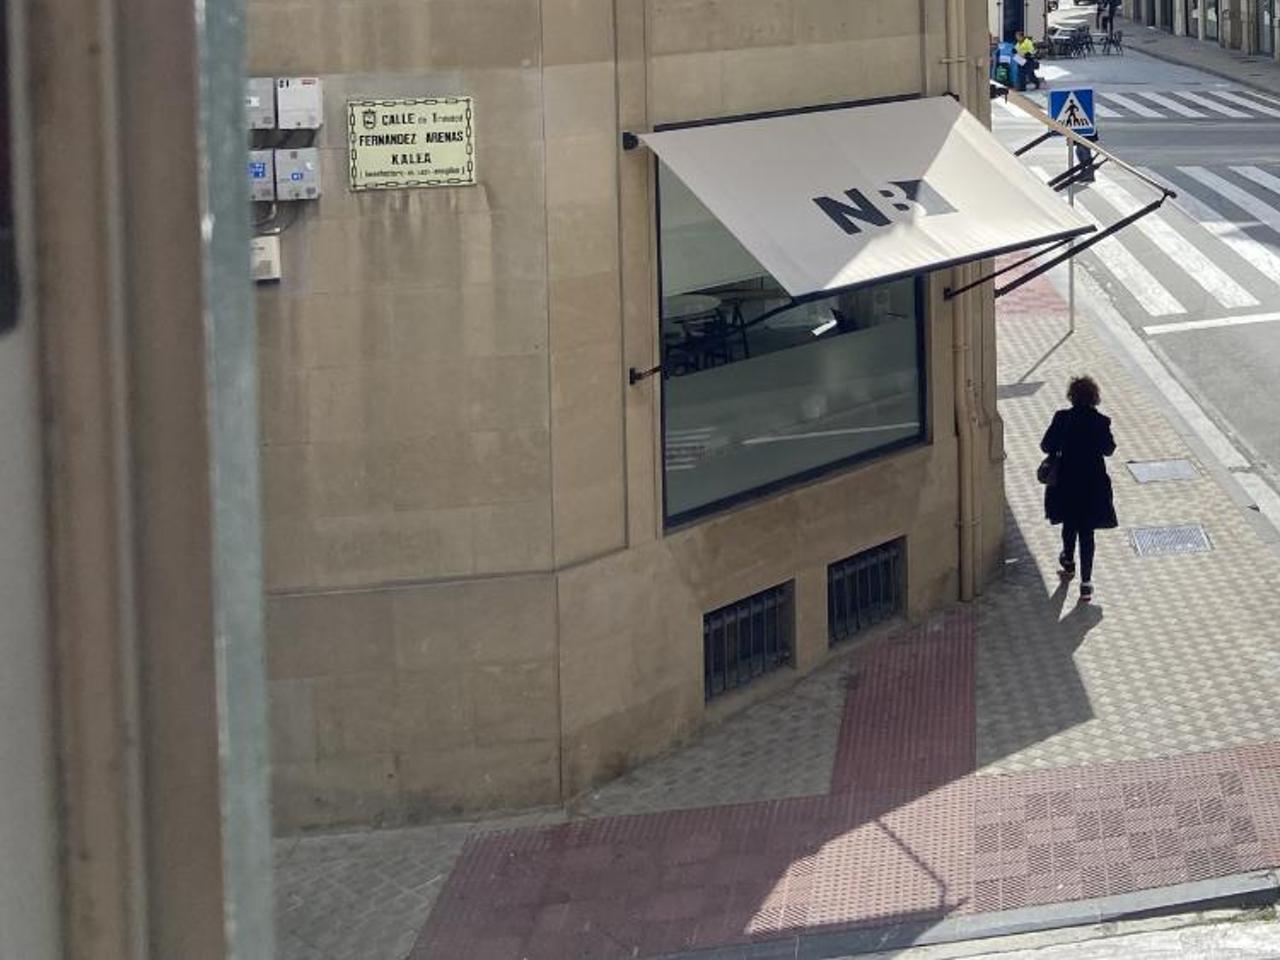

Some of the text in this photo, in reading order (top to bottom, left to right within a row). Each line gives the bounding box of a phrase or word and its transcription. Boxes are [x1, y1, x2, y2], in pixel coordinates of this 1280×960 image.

[382, 113, 415, 125] CALLE
[359, 131, 464, 147] FERNANDEZ ARENAS
[391, 152, 432, 165] KALEA
